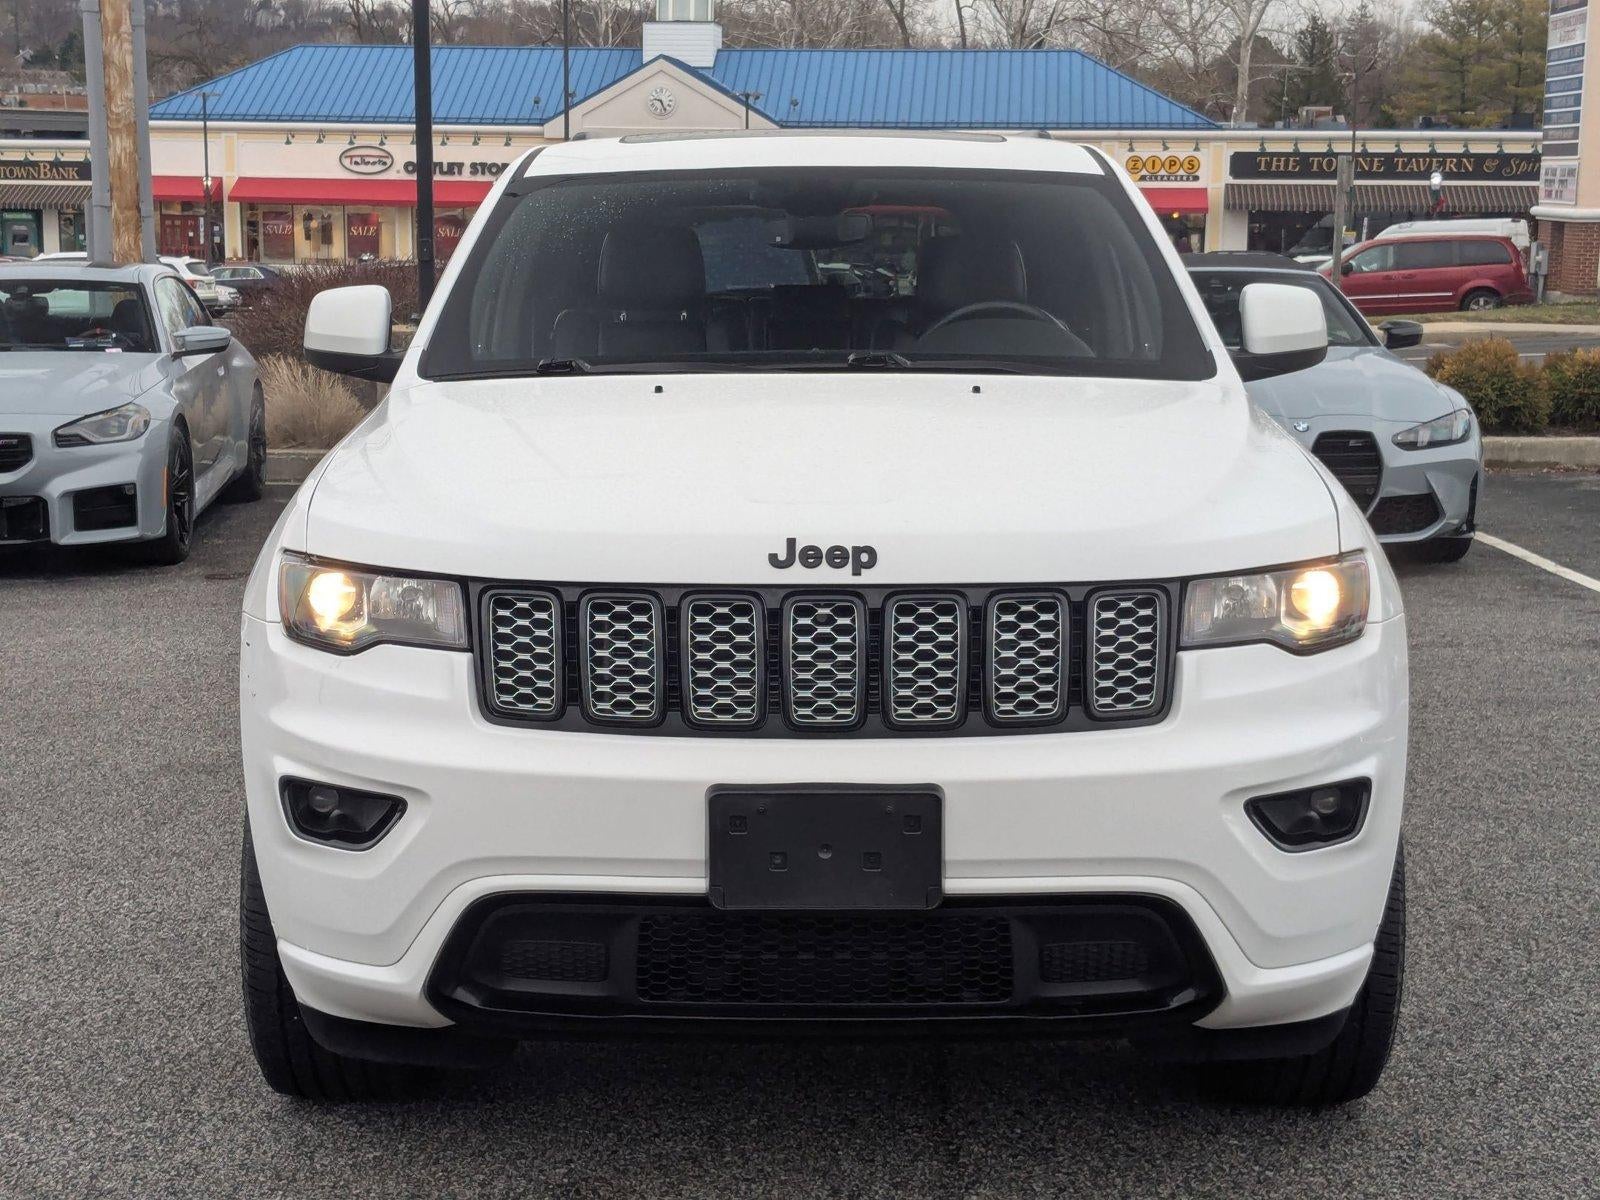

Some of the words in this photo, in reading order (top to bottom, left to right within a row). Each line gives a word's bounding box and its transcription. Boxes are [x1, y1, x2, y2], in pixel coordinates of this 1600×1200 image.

[403, 160, 465, 177] OTLET
[1129, 157, 1196, 172] ZIPS
[1257, 156, 1300, 172] THE
[1309, 156, 1385, 172] TONE
[1394, 157, 1475, 173] TAVERN
[1483, 158, 1499, 173] &
[265, 224, 292, 235] SALE
[350, 226, 376, 237] SALE
[768, 537, 877, 576] Jeep
